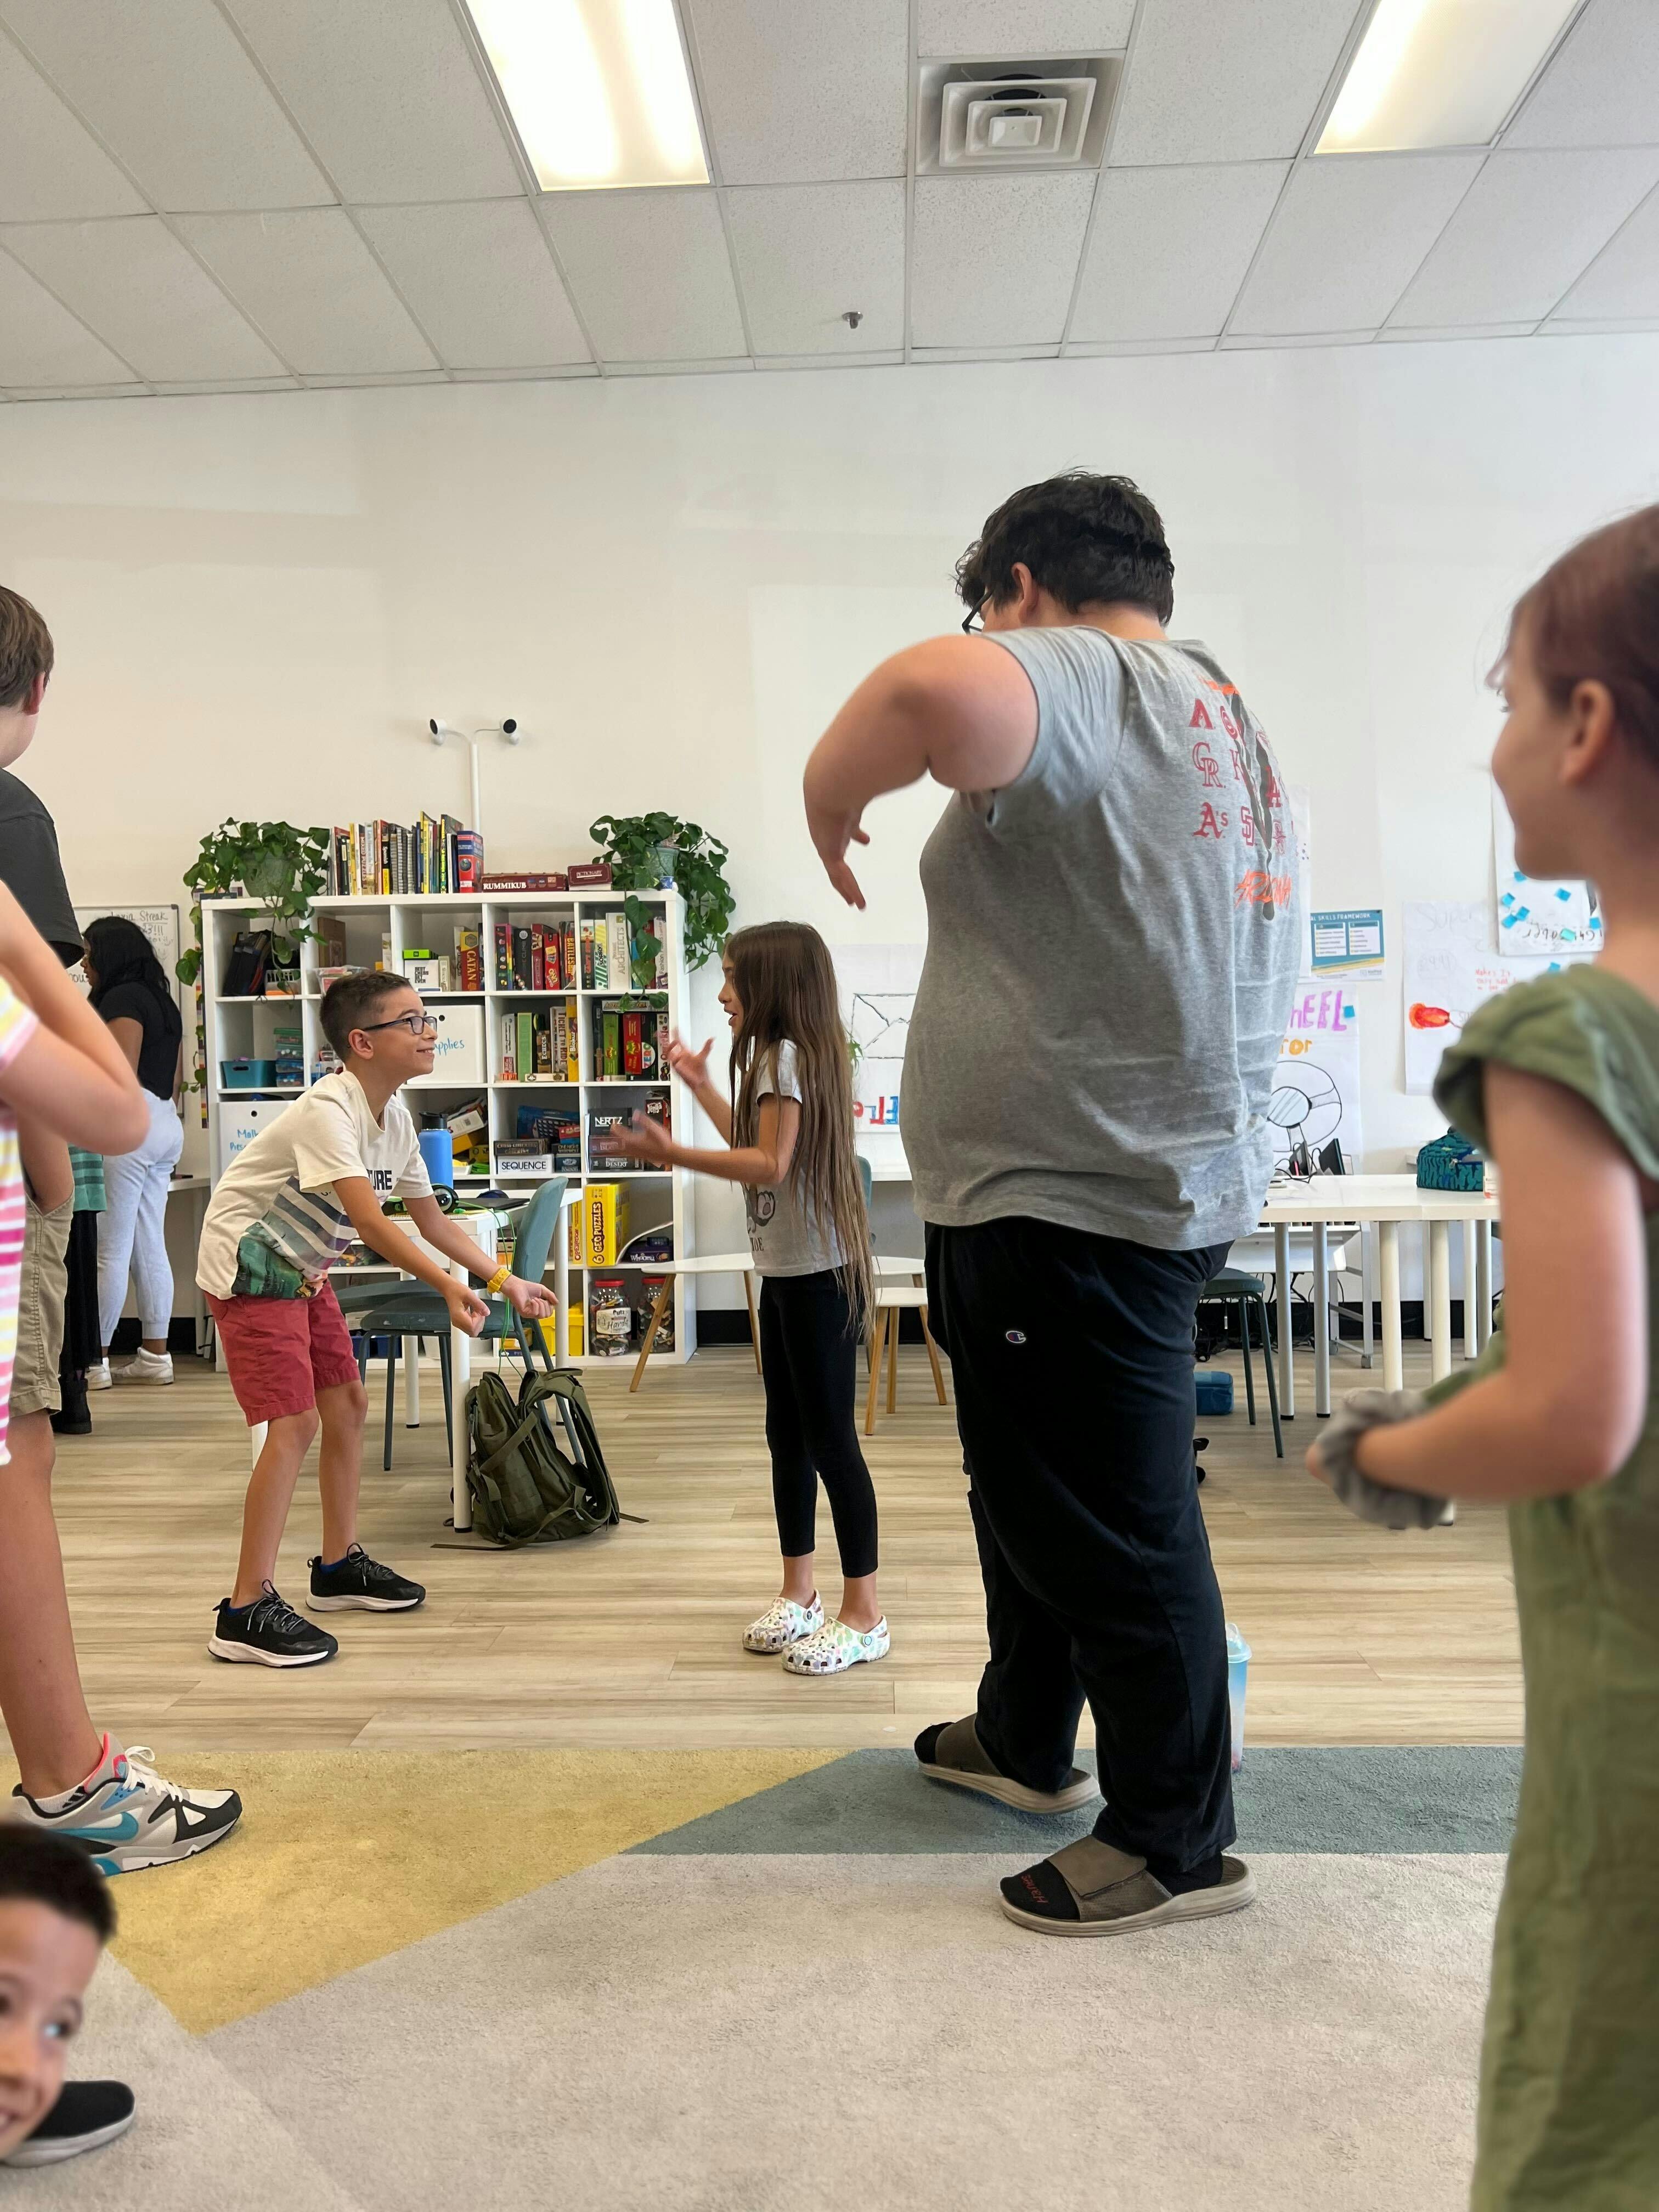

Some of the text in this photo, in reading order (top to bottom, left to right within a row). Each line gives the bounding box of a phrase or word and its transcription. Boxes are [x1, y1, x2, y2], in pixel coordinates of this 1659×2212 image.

[140, 910, 168, 922] Streak
[617, 927, 625, 975] ARCHITECTS
[466, 950, 477, 980] CATAN
[594, 1117, 623, 1127] NERTZ
[501, 1161, 546, 1170] SEQUENCE
